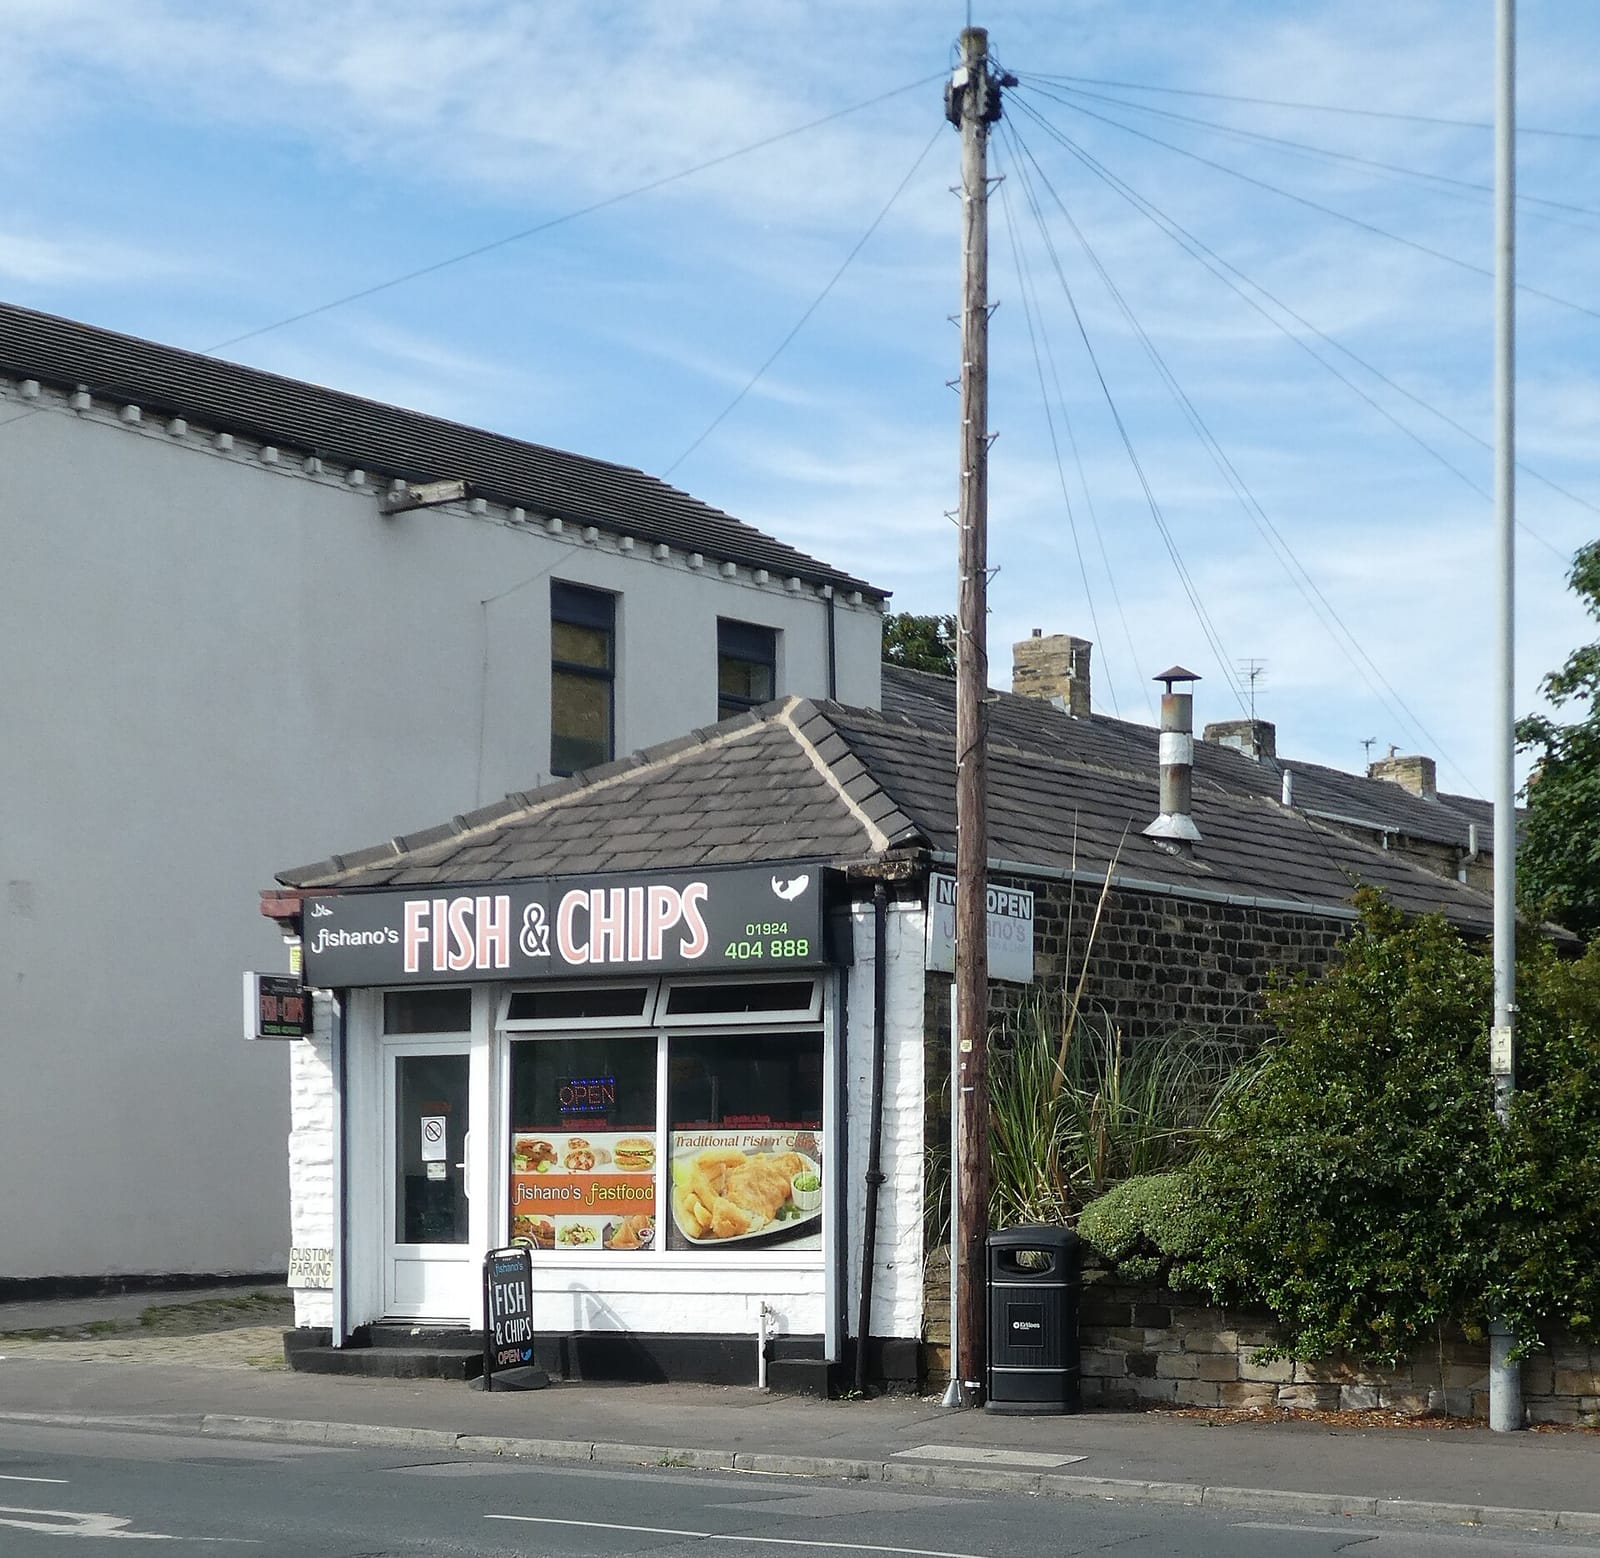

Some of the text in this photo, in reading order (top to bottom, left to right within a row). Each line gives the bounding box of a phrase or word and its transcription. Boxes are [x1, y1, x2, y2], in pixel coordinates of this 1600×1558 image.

[986, 889, 1031, 920] OPEN
[404, 882, 709, 973] FISH & CHIPS
[745, 922, 788, 936] 01924
[311, 926, 400, 954] fishano's
[724, 939, 809, 959] 404 888
[560, 1085, 615, 1105] OPEN
[676, 1134, 739, 1148] Traditional
[512, 1182, 654, 1206] fishano's fastfood
[290, 1262, 332, 1277] PARKING
[304, 1276, 330, 1289] ONLY
[495, 1281, 527, 1316] FISH
[496, 1317, 532, 1346] & CHIPS
[498, 1348, 520, 1364] OPEN
